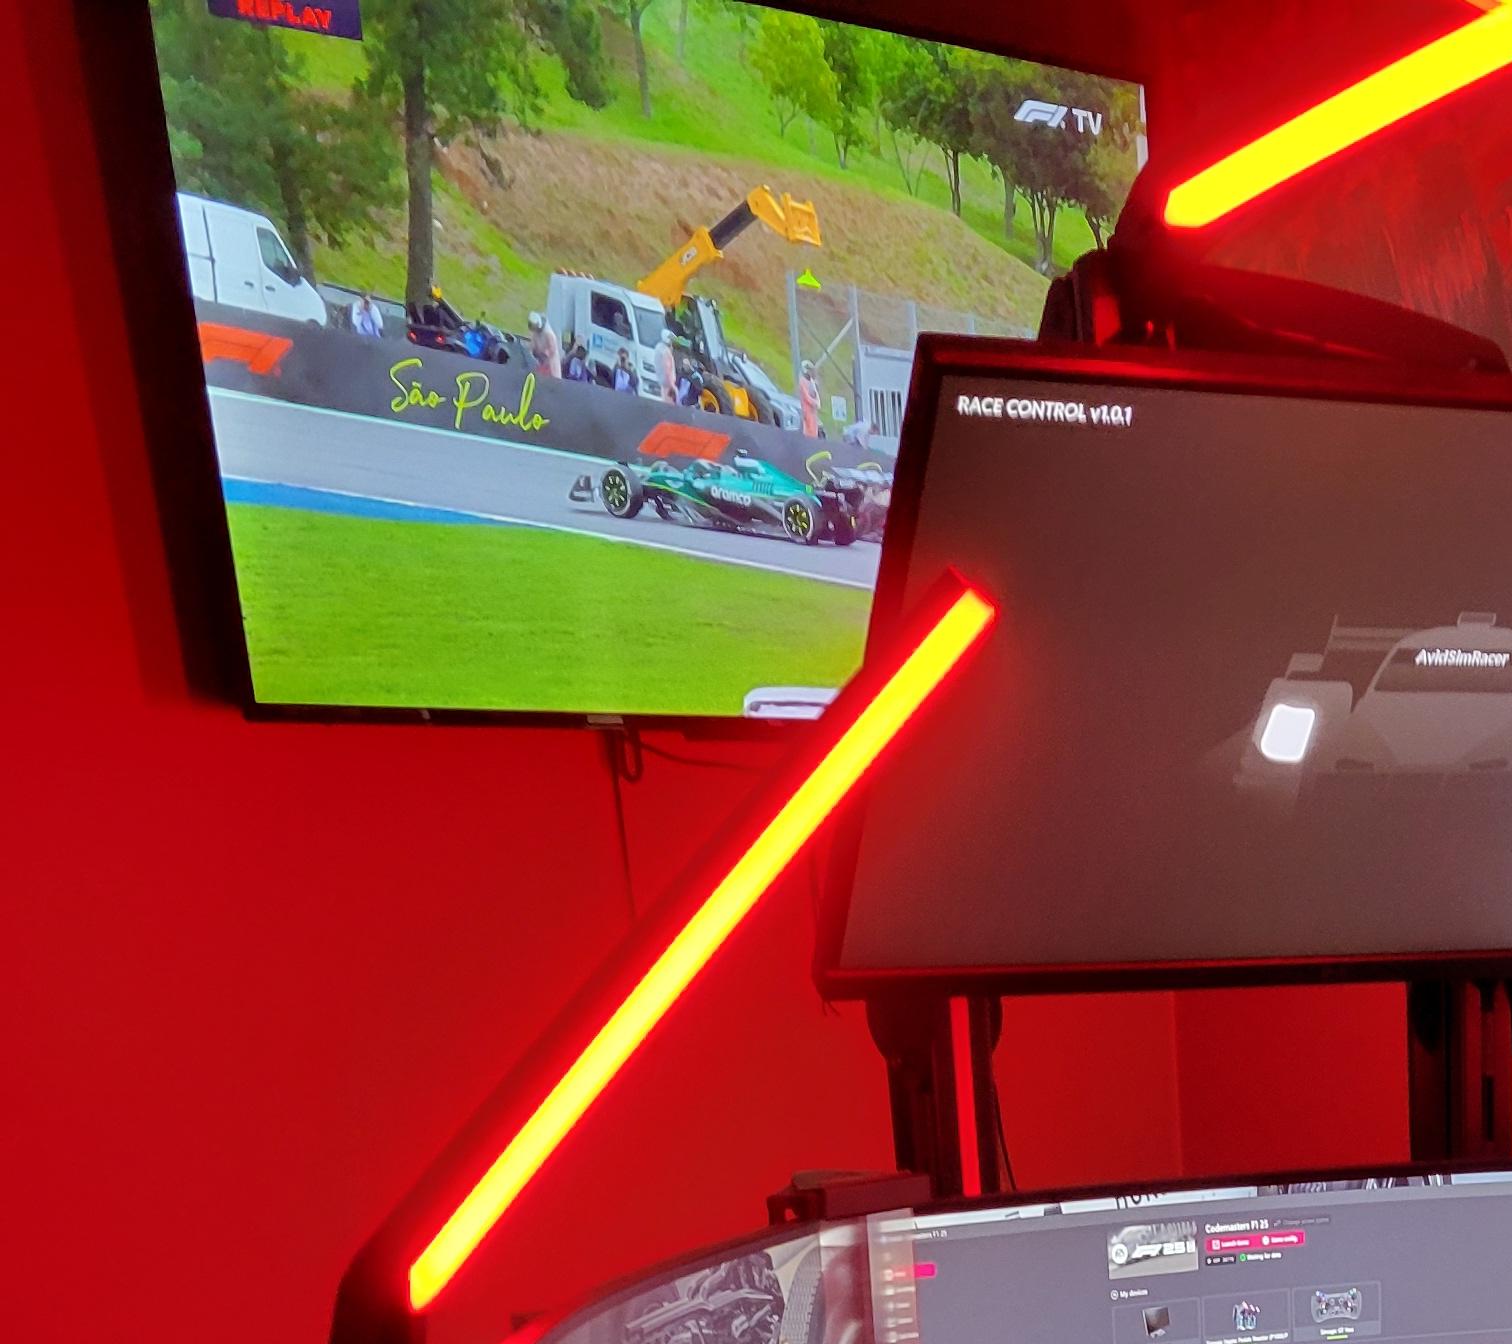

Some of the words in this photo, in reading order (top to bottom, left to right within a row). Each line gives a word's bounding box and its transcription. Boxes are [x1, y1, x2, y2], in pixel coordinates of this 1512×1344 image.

[1071, 107, 1103, 136] TV
[389, 357, 447, 413] São
[453, 371, 550, 431] Paulo
[958, 394, 1003, 418] RACE
[1006, 398, 1087, 424] CONTROL
[1090, 404, 1133, 428] v1.0.1
[710, 484, 752, 507] aramco
[1415, 647, 1511, 669] AvidSimRacer
[1205, 1221, 1250, 1234] Codemasters
